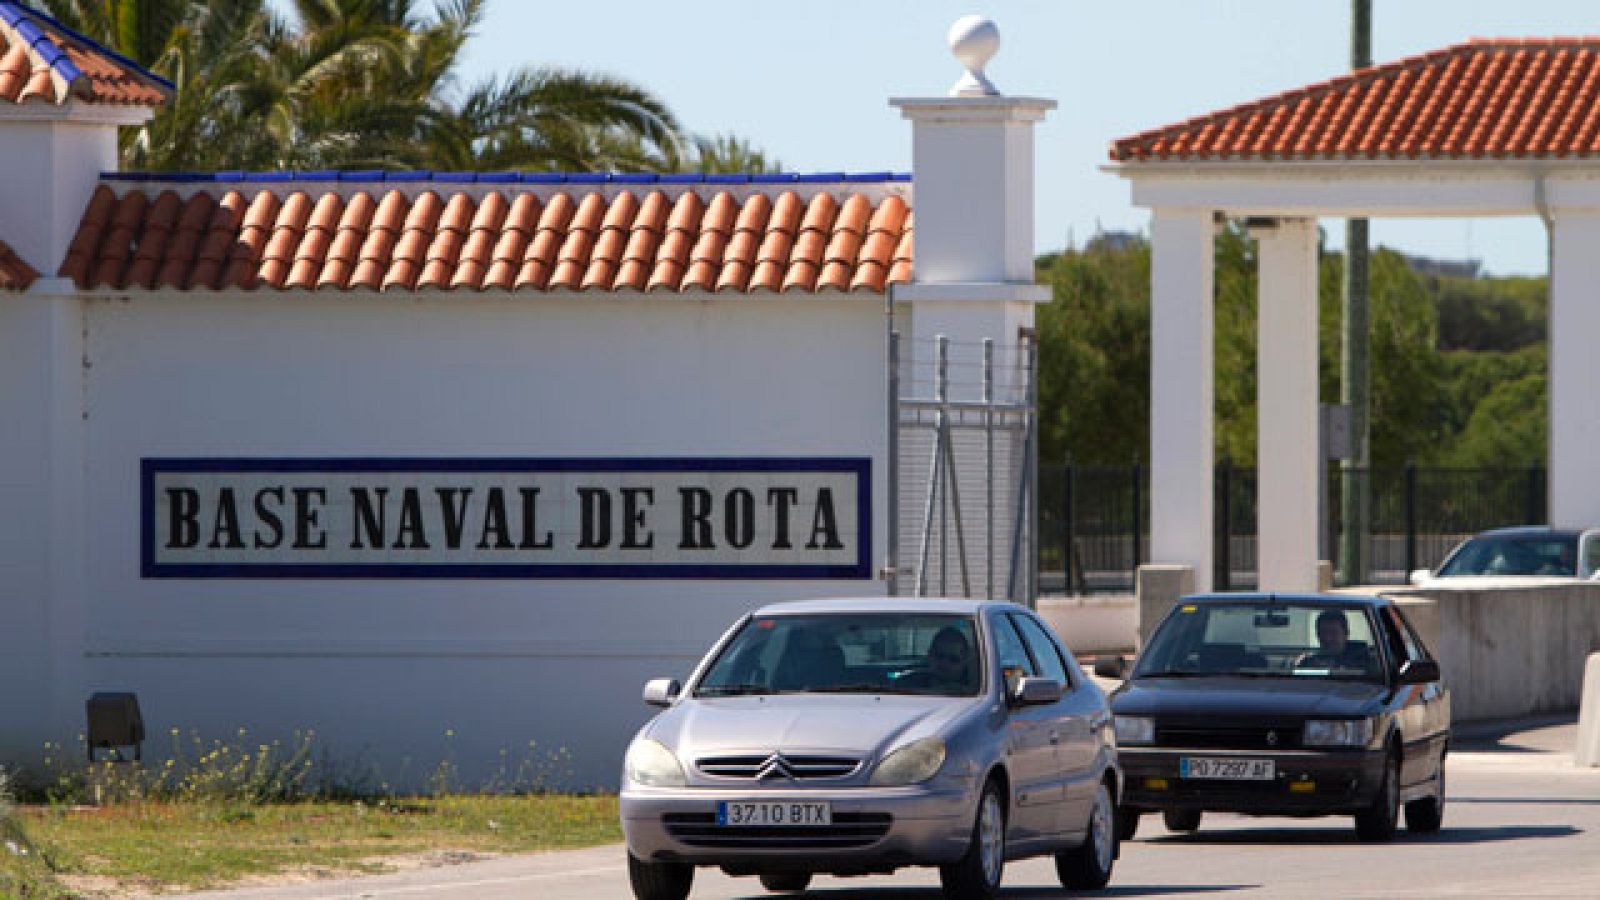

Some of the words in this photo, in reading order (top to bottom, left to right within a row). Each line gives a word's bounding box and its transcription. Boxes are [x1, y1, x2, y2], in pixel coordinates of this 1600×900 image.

[164, 485, 328, 551] BASE
[349, 486, 554, 551] NAVAL
[576, 487, 654, 551] DE
[677, 487, 844, 551] ROTA
[732, 804, 784, 823] 3710
[790, 804, 826, 823] BTX
